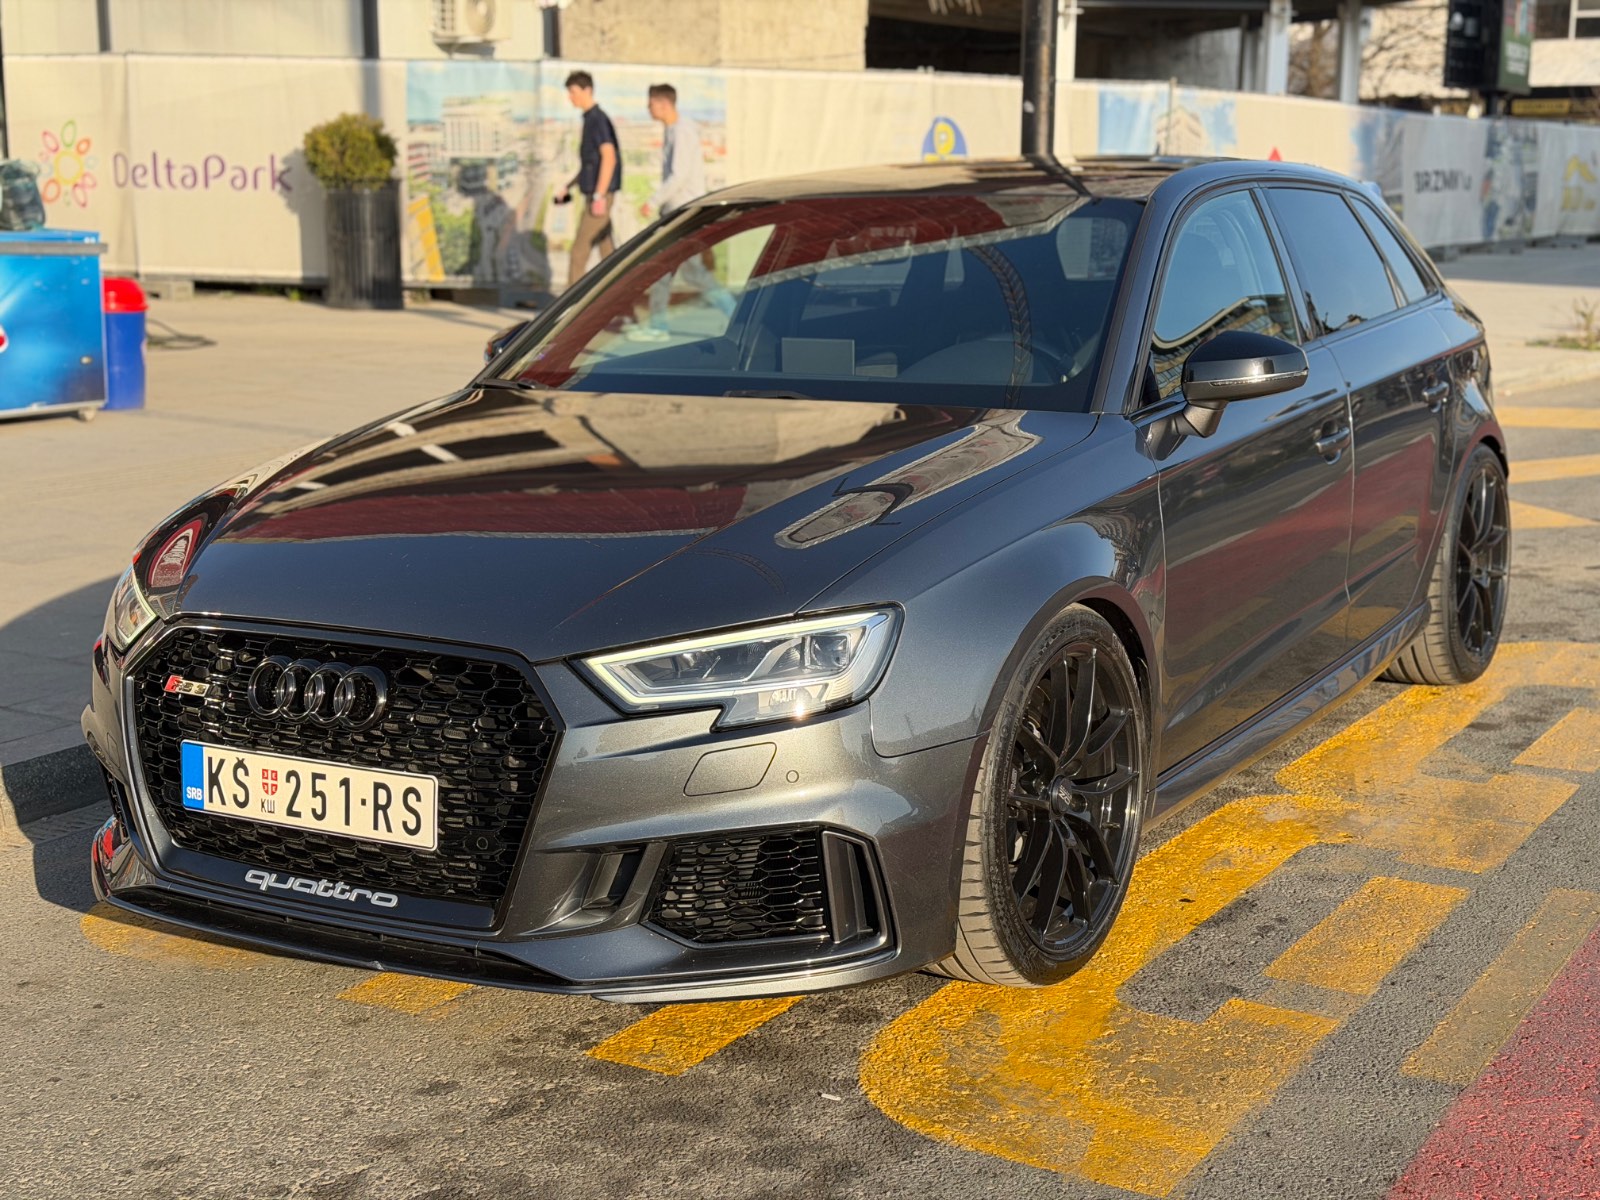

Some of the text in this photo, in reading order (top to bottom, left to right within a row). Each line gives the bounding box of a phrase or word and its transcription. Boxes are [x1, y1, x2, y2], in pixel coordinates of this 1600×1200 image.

[113, 151, 292, 191] DeltaPark
[186, 786, 203, 801] SRB
[207, 756, 250, 809] KŠ
[244, 869, 399, 908] quattro
